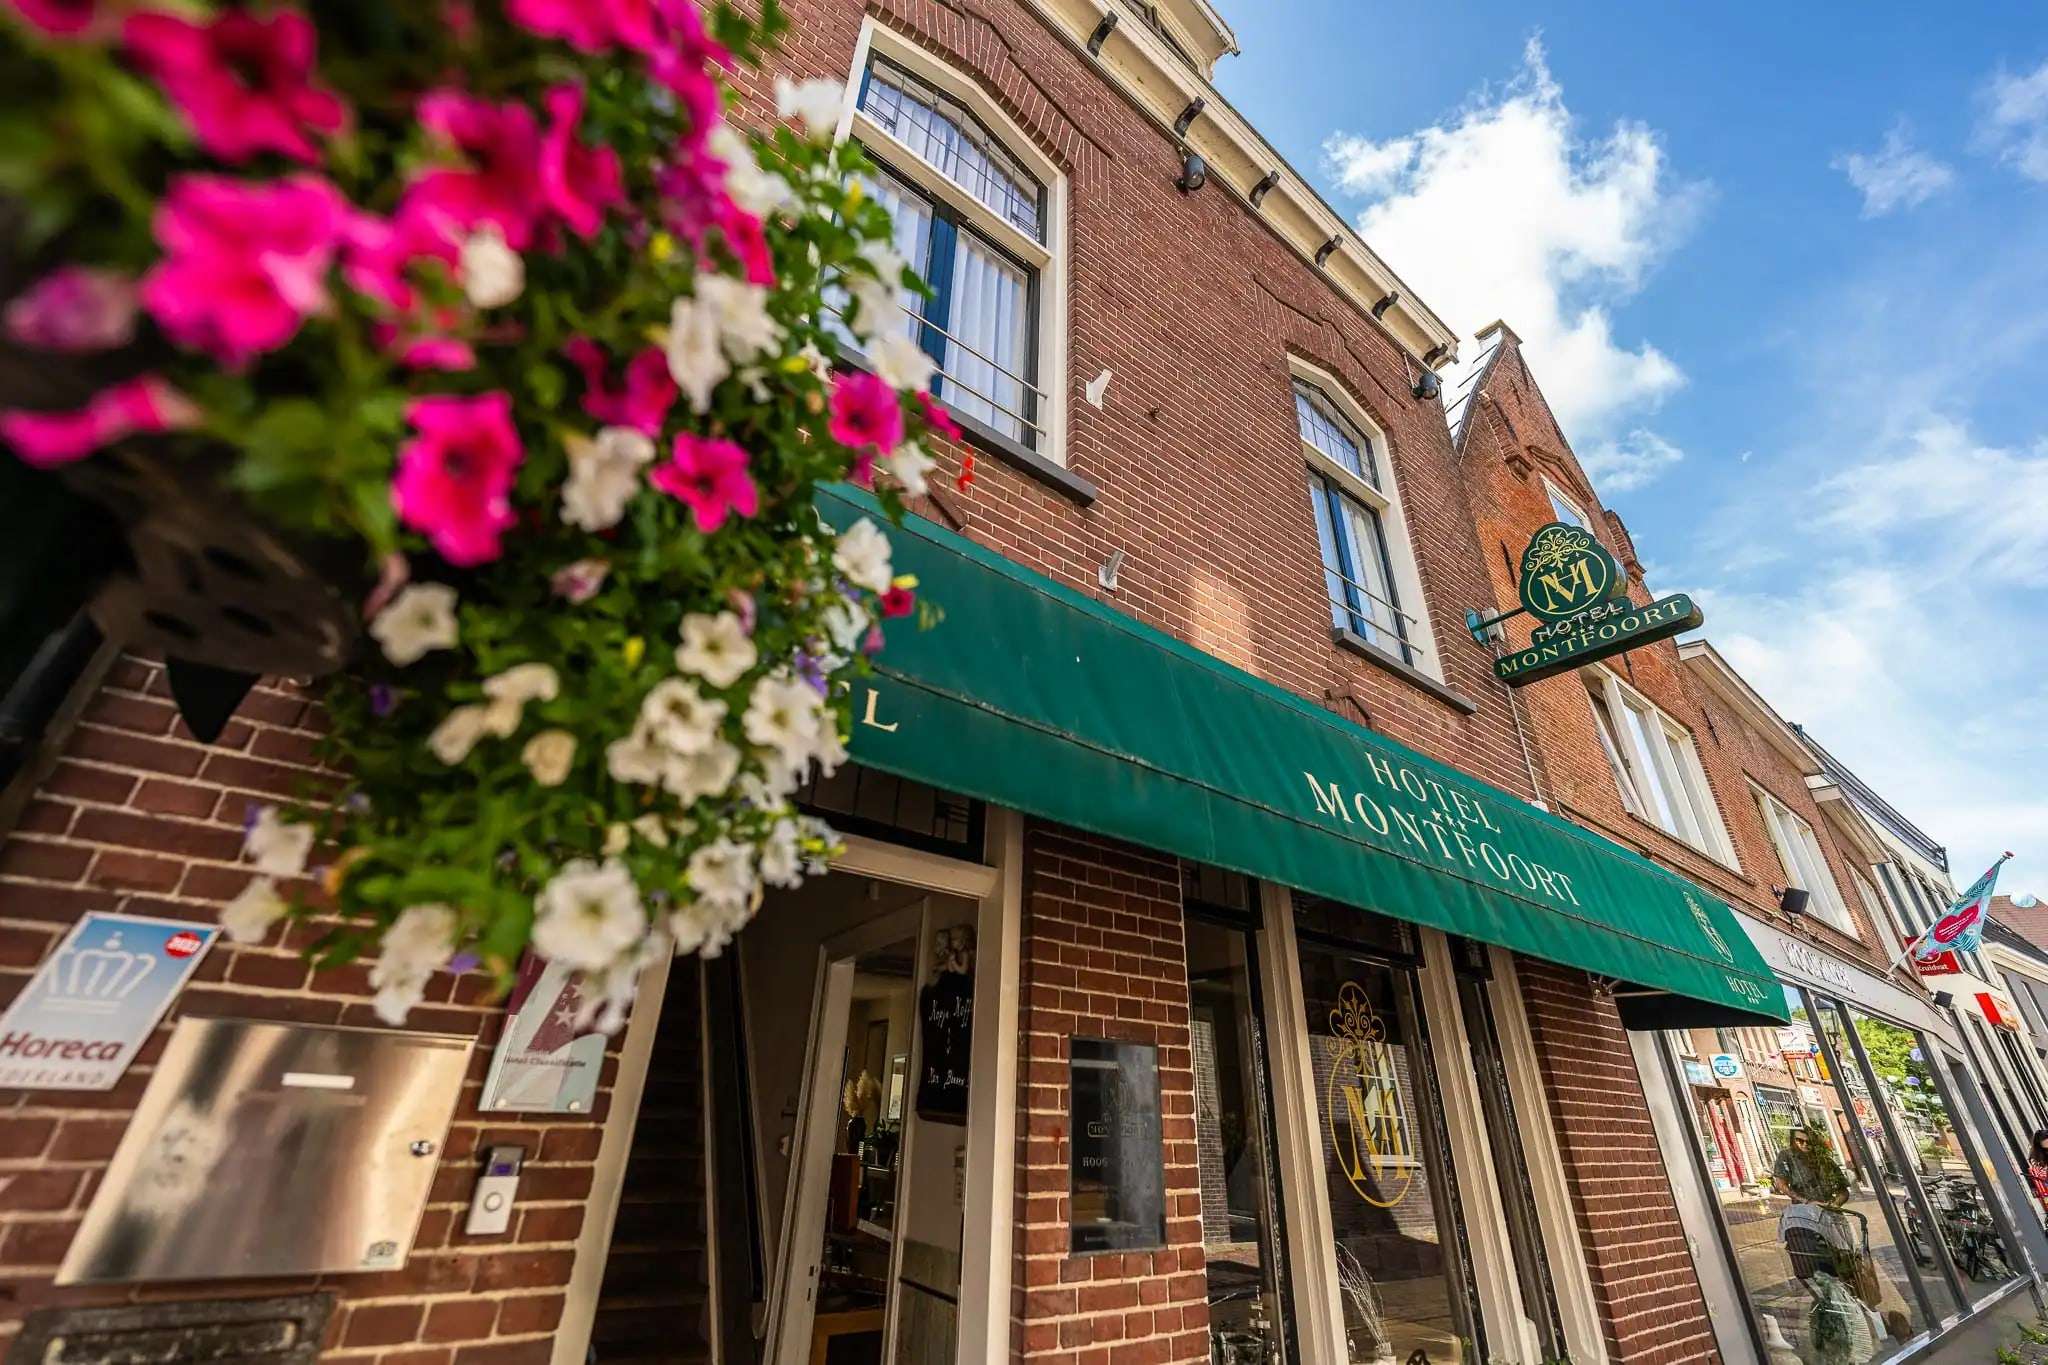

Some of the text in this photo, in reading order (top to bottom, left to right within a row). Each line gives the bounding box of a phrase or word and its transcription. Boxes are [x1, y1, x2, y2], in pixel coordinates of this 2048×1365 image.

[1501, 599, 1682, 676] MONTFOORT
[1536, 601, 1624, 642] HOTEL
[1364, 752, 1501, 833] HOTEL
[1303, 771, 1581, 906] MONTFOORT
[1725, 975, 1769, 999] HOTEL
[0, 1031, 125, 1061] Horeca
